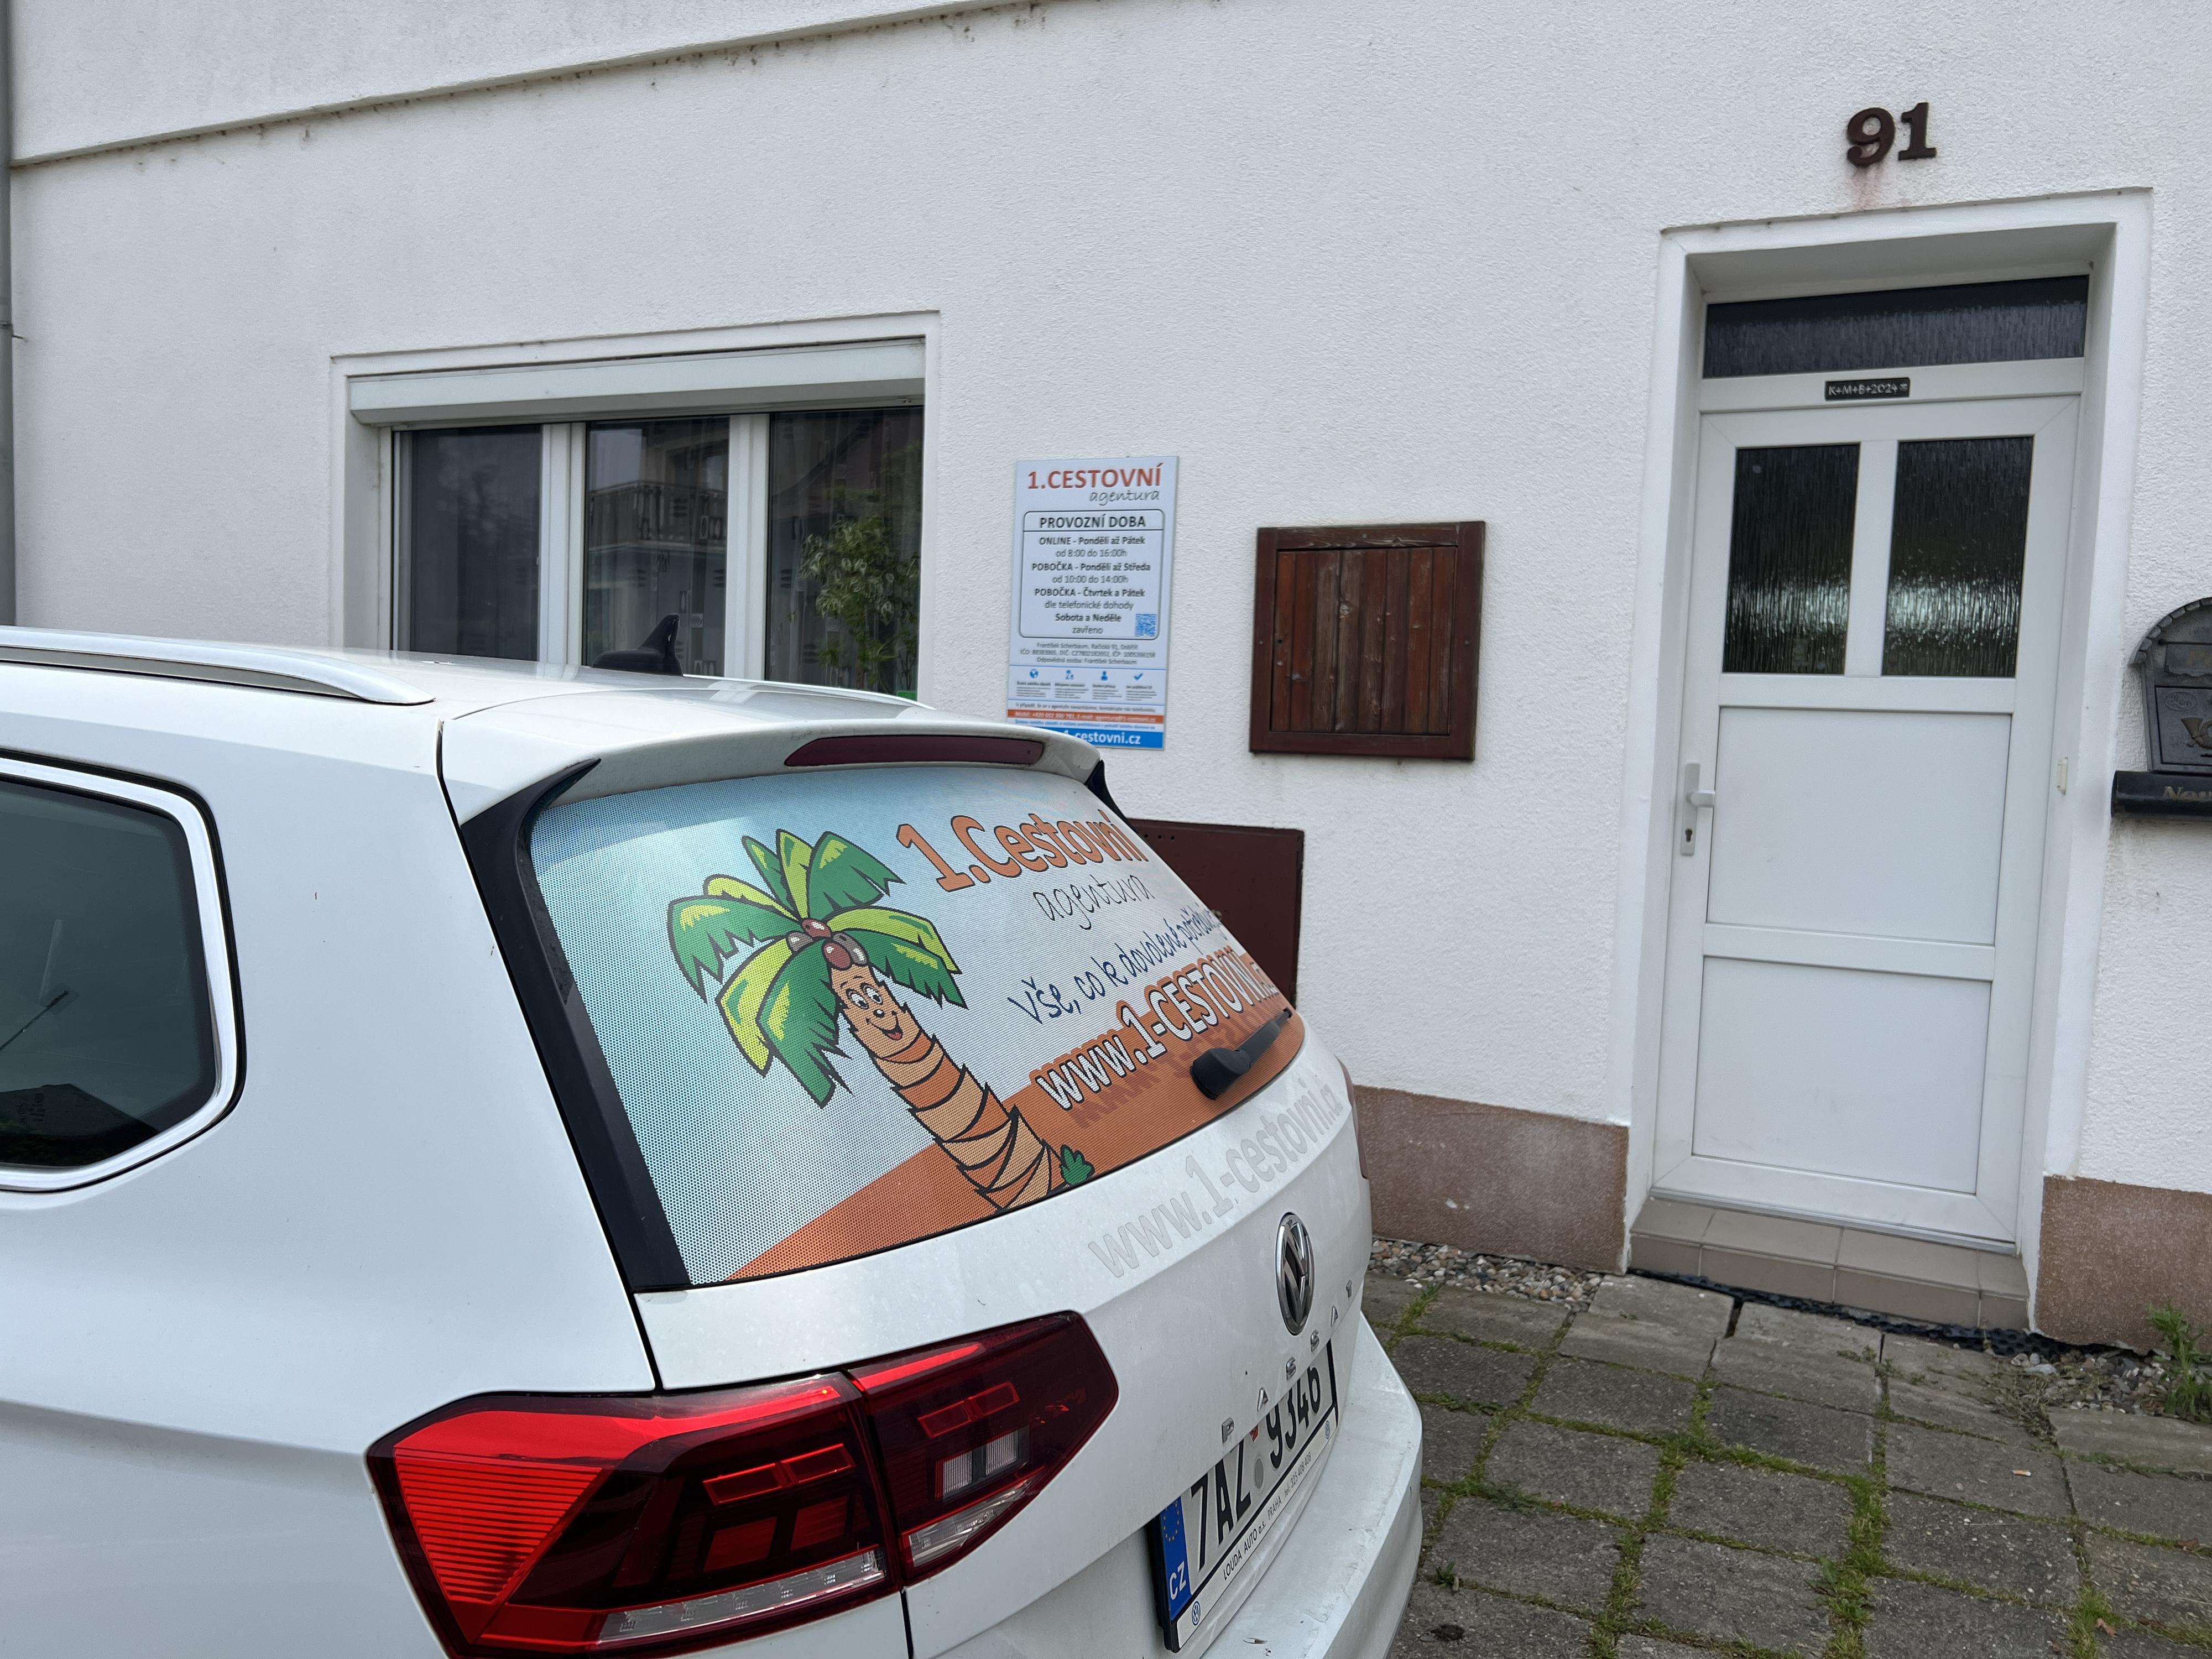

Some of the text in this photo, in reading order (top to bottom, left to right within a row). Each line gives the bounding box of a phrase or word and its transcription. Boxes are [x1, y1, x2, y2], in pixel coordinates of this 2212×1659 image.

[1847, 102, 1937, 167] 91
[1027, 463, 1164, 489] 1.CESTOVNÍ
[1089, 490, 1160, 506] agentura
[1040, 514, 1146, 528] PROVOZNÍ DOBA
[1039, 537, 1071, 545] ONLINE
[1079, 536, 1109, 545] Pondělí
[1110, 536, 1120, 545] až
[1122, 536, 1145, 544] Pátek
[1056, 549, 1066, 557] od
[1068, 549, 1086, 557] 8:00
[1087, 549, 1098, 557] do
[1032, 561, 1073, 571] POBOČKA
[1081, 562, 1111, 571] Pondělí
[1113, 562, 1123, 571] až
[1124, 562, 1151, 571] Středa
[1052, 575, 1062, 583] od
[1065, 575, 1087, 583] 10:00
[1088, 575, 1100, 583] do
[1035, 587, 1076, 597] POBOČKA
[1083, 587, 1113, 597] Čtvrtek
[1122, 588, 1145, 597] Pátek
[1045, 601, 1134, 611] dle telefonické dohody
[1055, 613, 1083, 622] Sobota
[1093, 613, 1121, 622] Neděle
[1072, 626, 1103, 634] zavřeno
[1062, 729, 1141, 744] cestovni.cz
[1033, 874, 1155, 930] agentura
[1007, 977, 1081, 1024] Vše,
[1074, 972, 1105, 1000] co
[1091, 956, 1128, 987] k
[1114, 917, 1187, 977] dovolené
[1223, 1548, 1243, 1580] LOUDA
[1244, 1528, 1258, 1554] AUTO
[1258, 1521, 1266, 1535] a.s.
[1267, 1495, 1282, 1521] PRAHA
[1168, 1560, 1187, 1601] CZ
